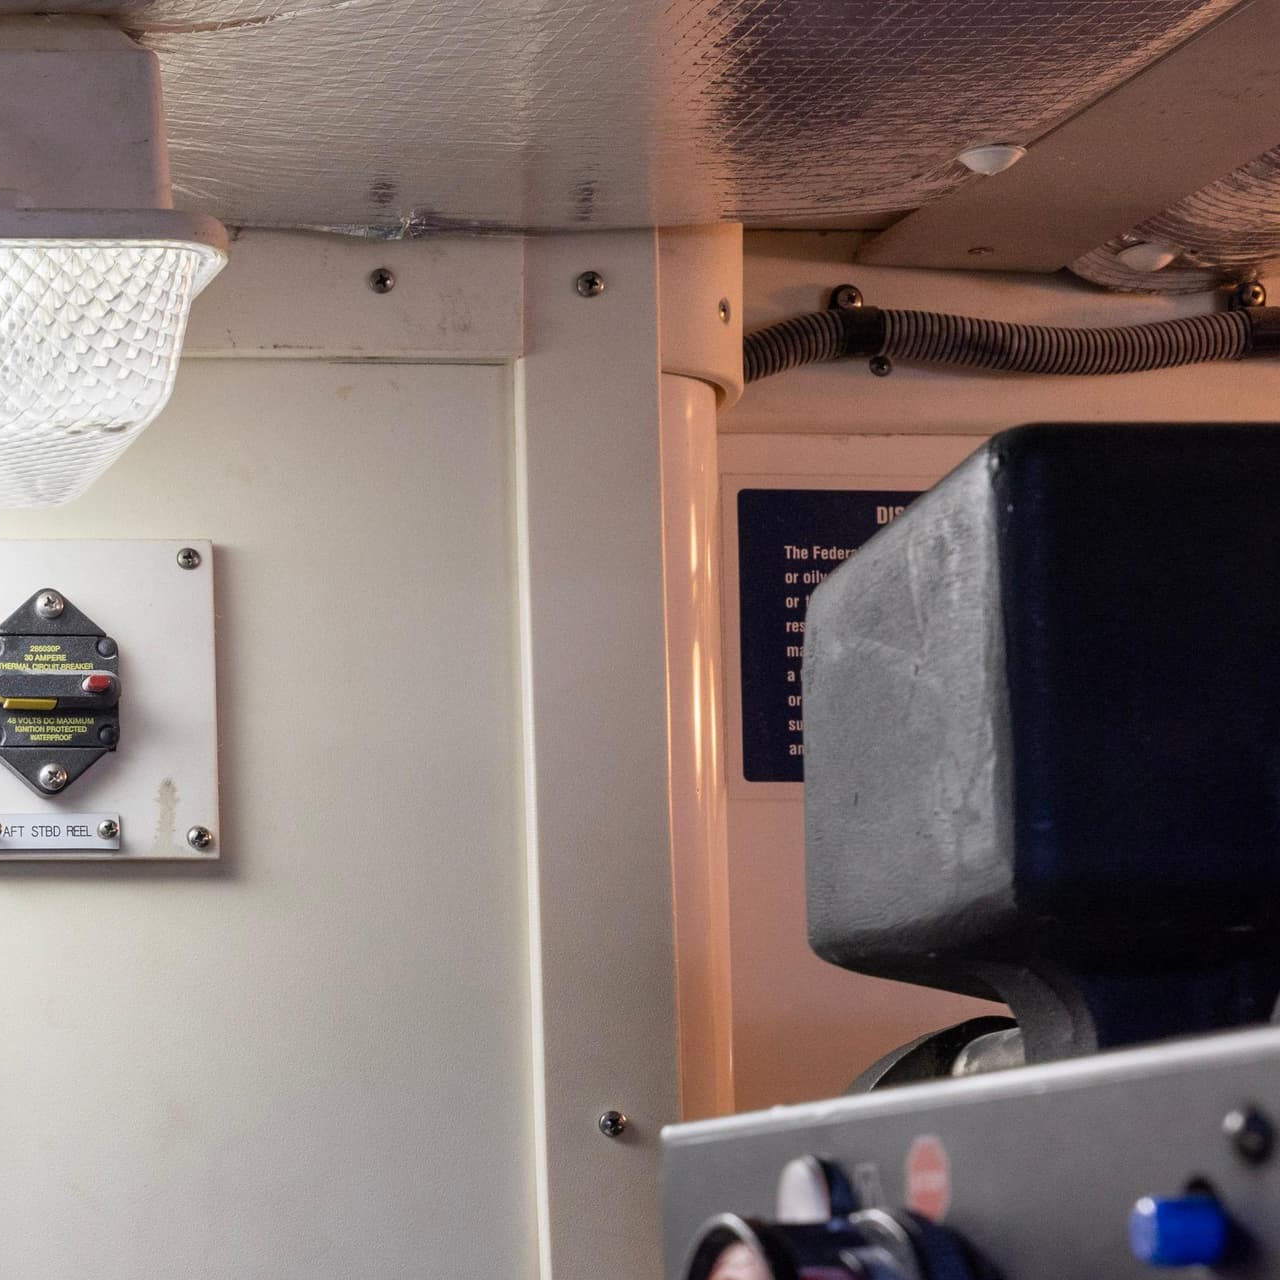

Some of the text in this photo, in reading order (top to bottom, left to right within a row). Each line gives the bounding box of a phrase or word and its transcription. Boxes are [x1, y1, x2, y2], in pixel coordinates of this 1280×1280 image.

[784, 545, 809, 560] The
[785, 572, 799, 584] or
[785, 597, 800, 609] or
[34, 654, 67, 662] AMPERE
[32, 662, 60, 670] CIRCUIT
[62, 662, 94, 670] BREAKER
[15, 725, 88, 733] IGNITION PROTECTED
[2, 825, 93, 838] AFT STBD REEL
